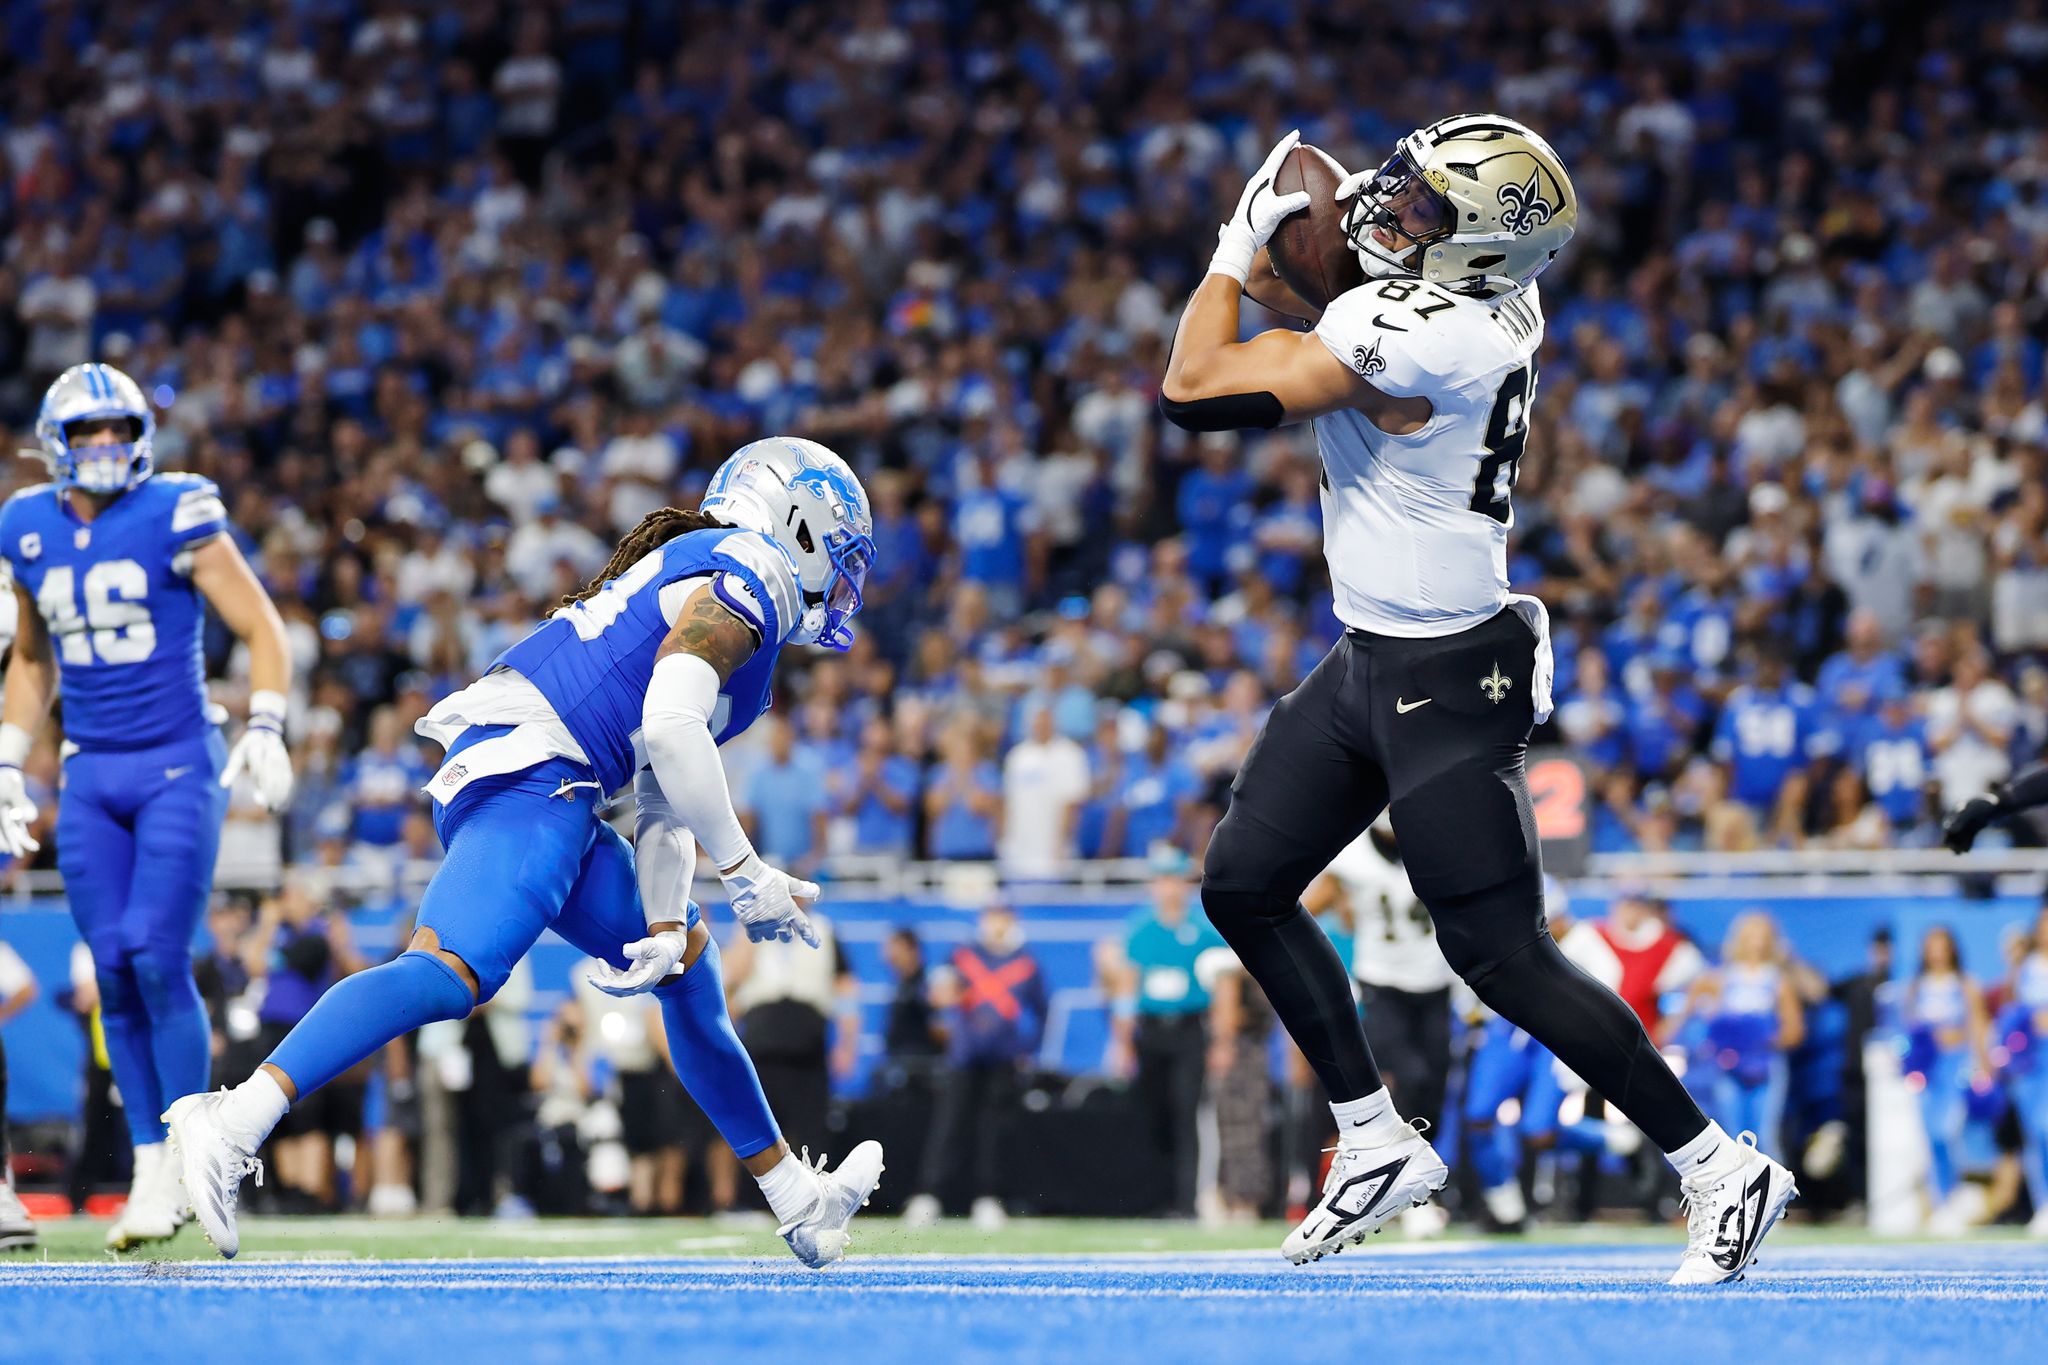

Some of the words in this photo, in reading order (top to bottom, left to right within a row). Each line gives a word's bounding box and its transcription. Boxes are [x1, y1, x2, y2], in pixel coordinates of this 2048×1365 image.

[1377, 280, 1457, 321] 87
[1469, 364, 1538, 525] 8
[37, 558, 157, 666] 46
[1527, 758, 1586, 839] 2
[1356, 1183, 1379, 1210] ALPHA
